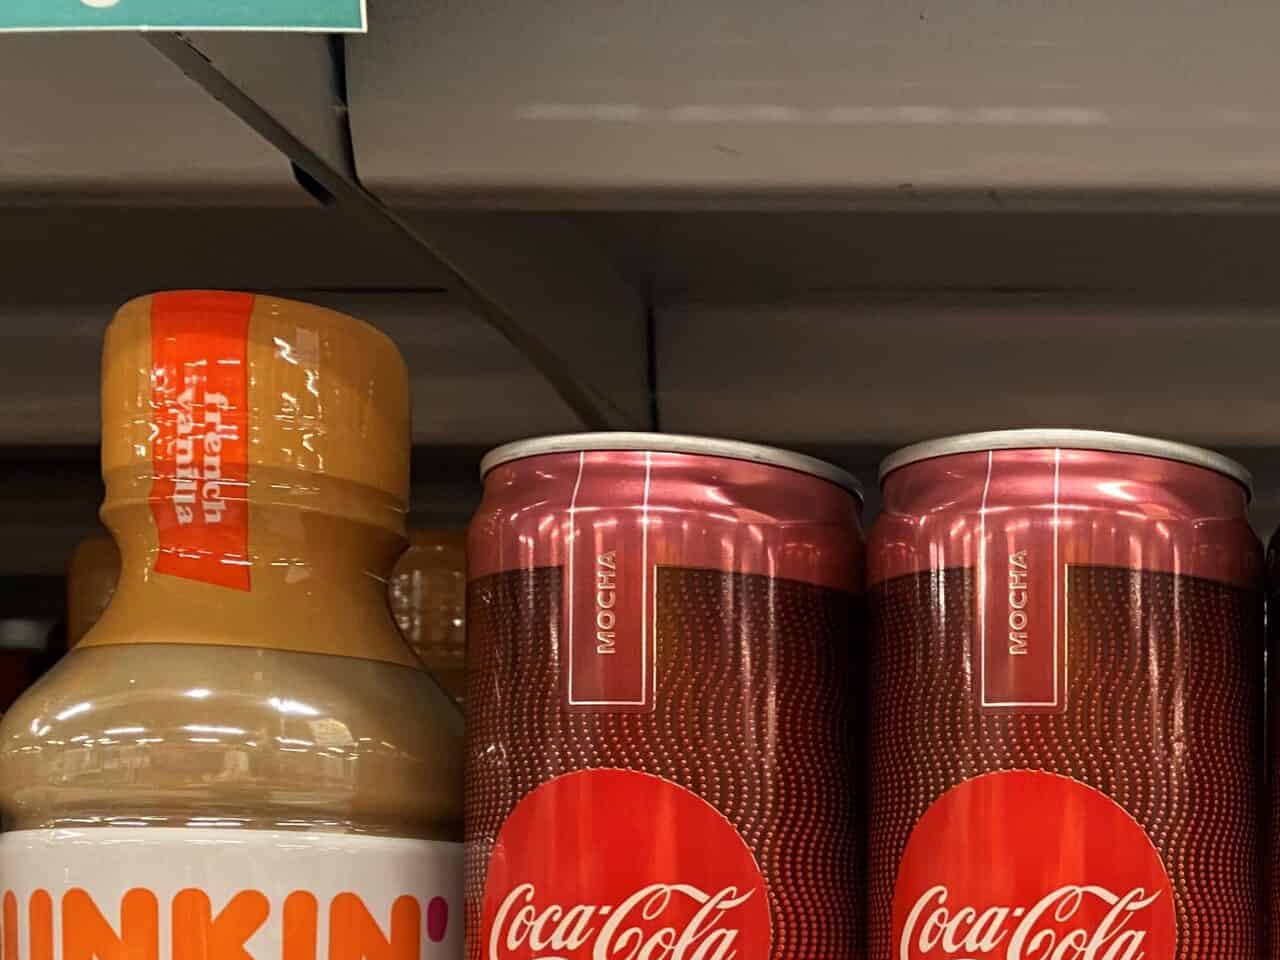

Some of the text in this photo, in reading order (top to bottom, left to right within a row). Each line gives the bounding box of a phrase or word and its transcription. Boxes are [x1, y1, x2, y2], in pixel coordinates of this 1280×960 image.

[174, 390, 196, 526] vanilla
[204, 391, 230, 526] french
[595, 550, 616, 656] MOCHA
[1008, 549, 1027, 657] MOCHA
